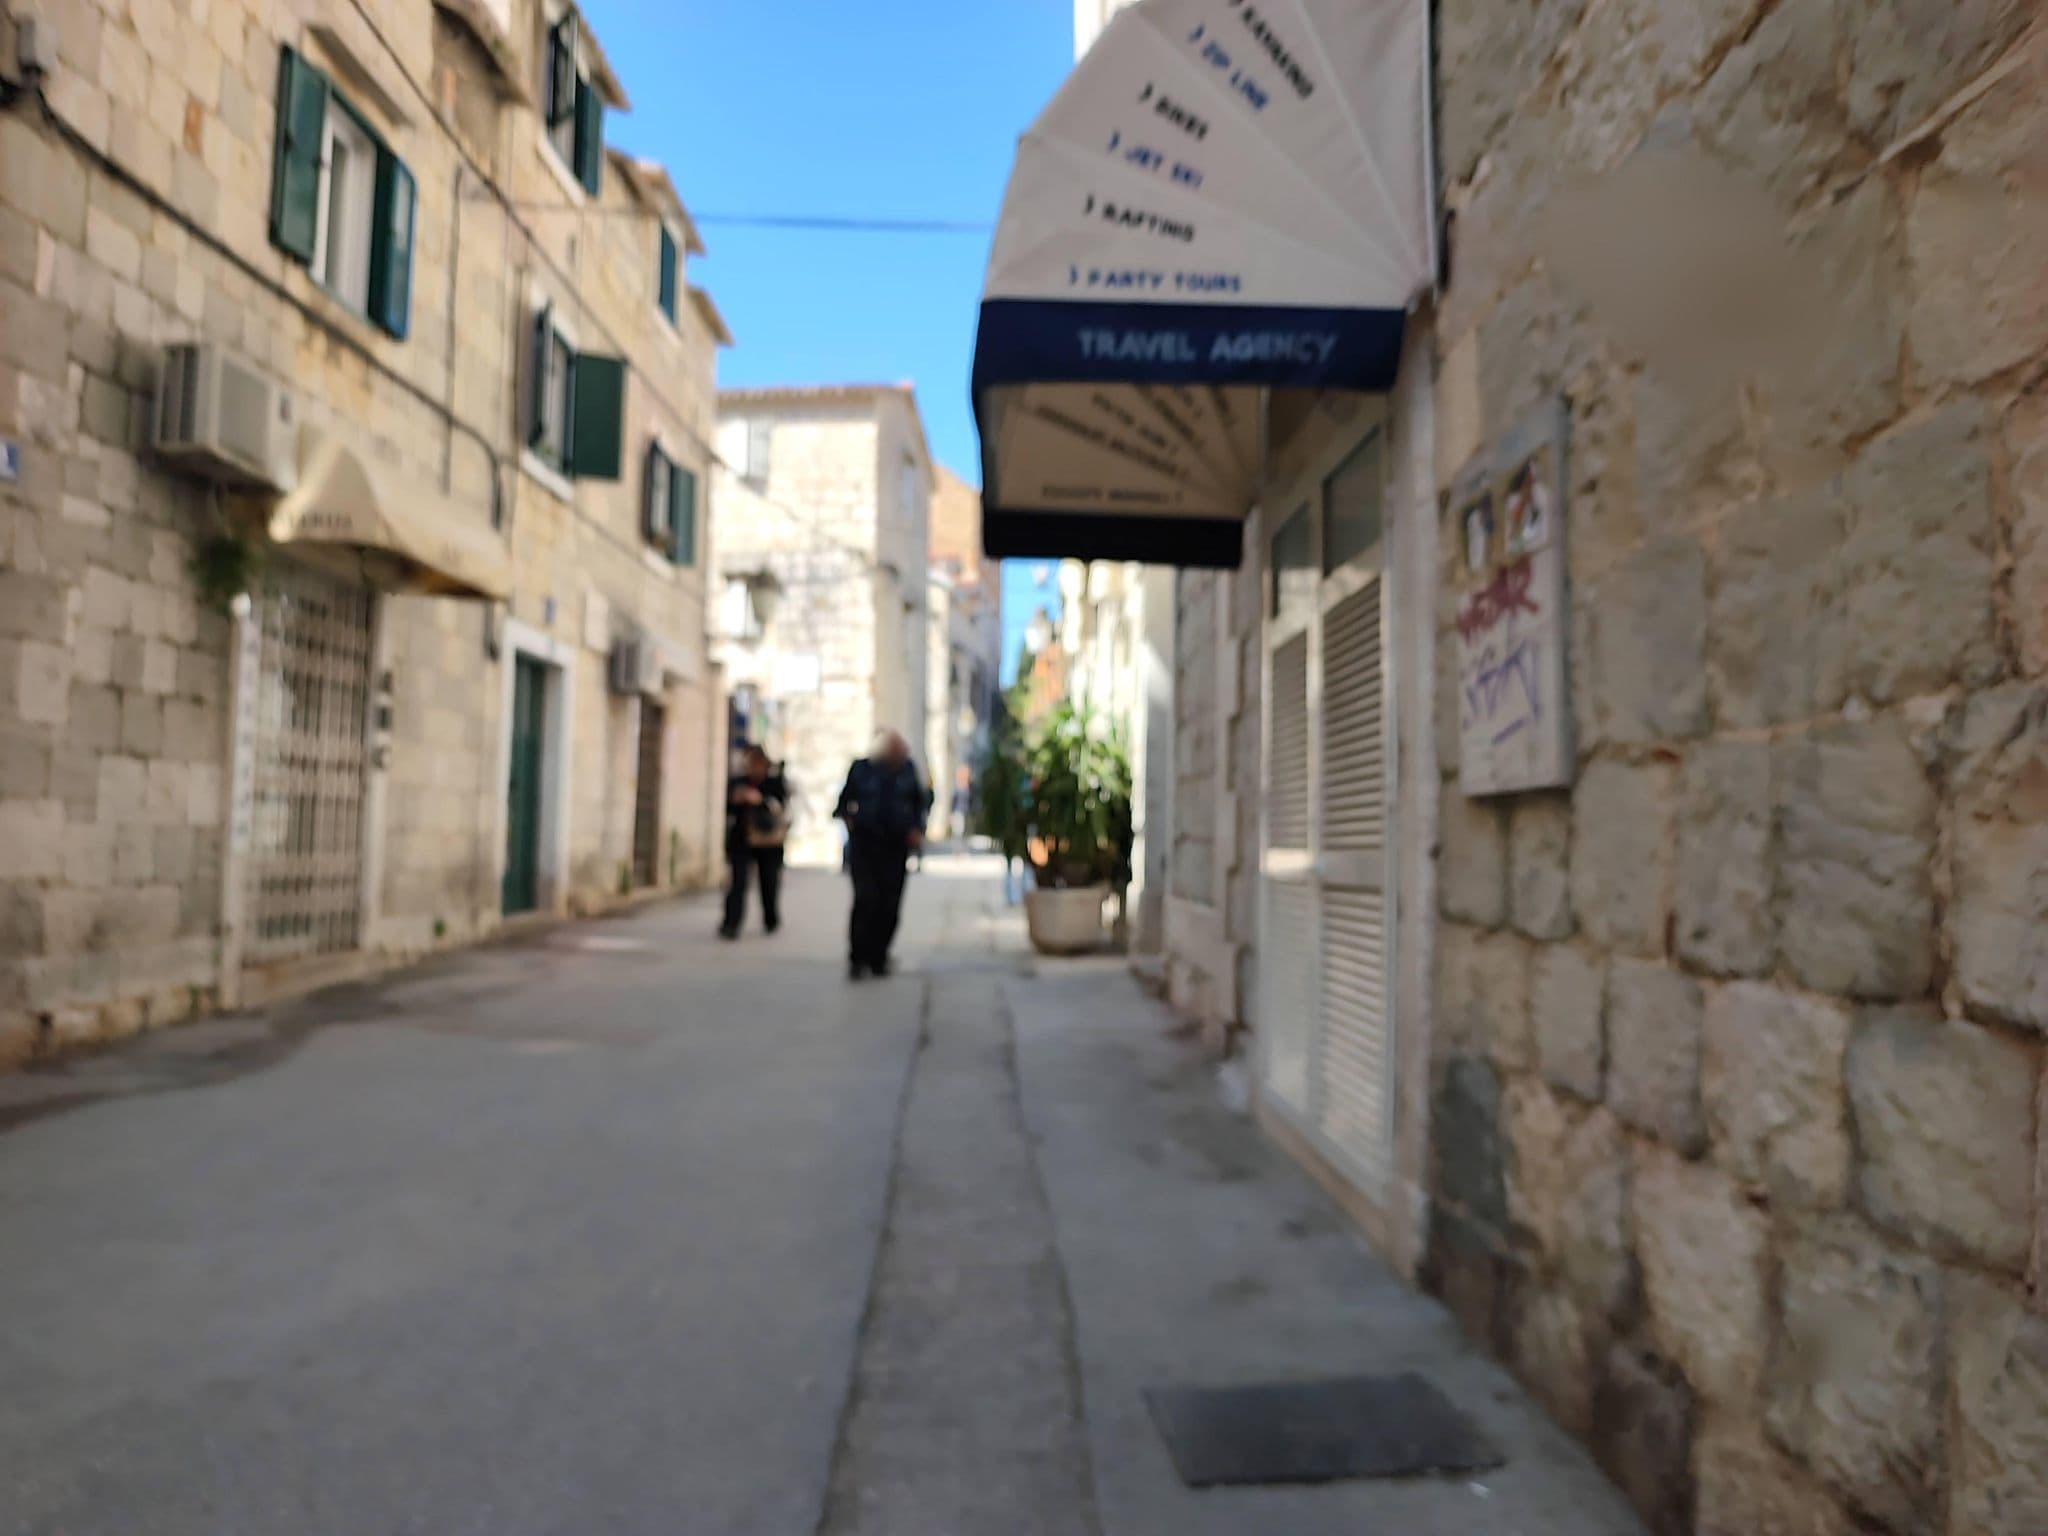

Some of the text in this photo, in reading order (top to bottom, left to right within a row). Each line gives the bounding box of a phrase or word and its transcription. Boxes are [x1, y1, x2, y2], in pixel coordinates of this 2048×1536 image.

[1125, 146, 1163, 171] JET
[1103, 202, 1196, 243] RAFTING
[1088, 268, 1241, 292] PARTY TOURS
[1079, 328, 1338, 364] TRAVEL AGENCY
